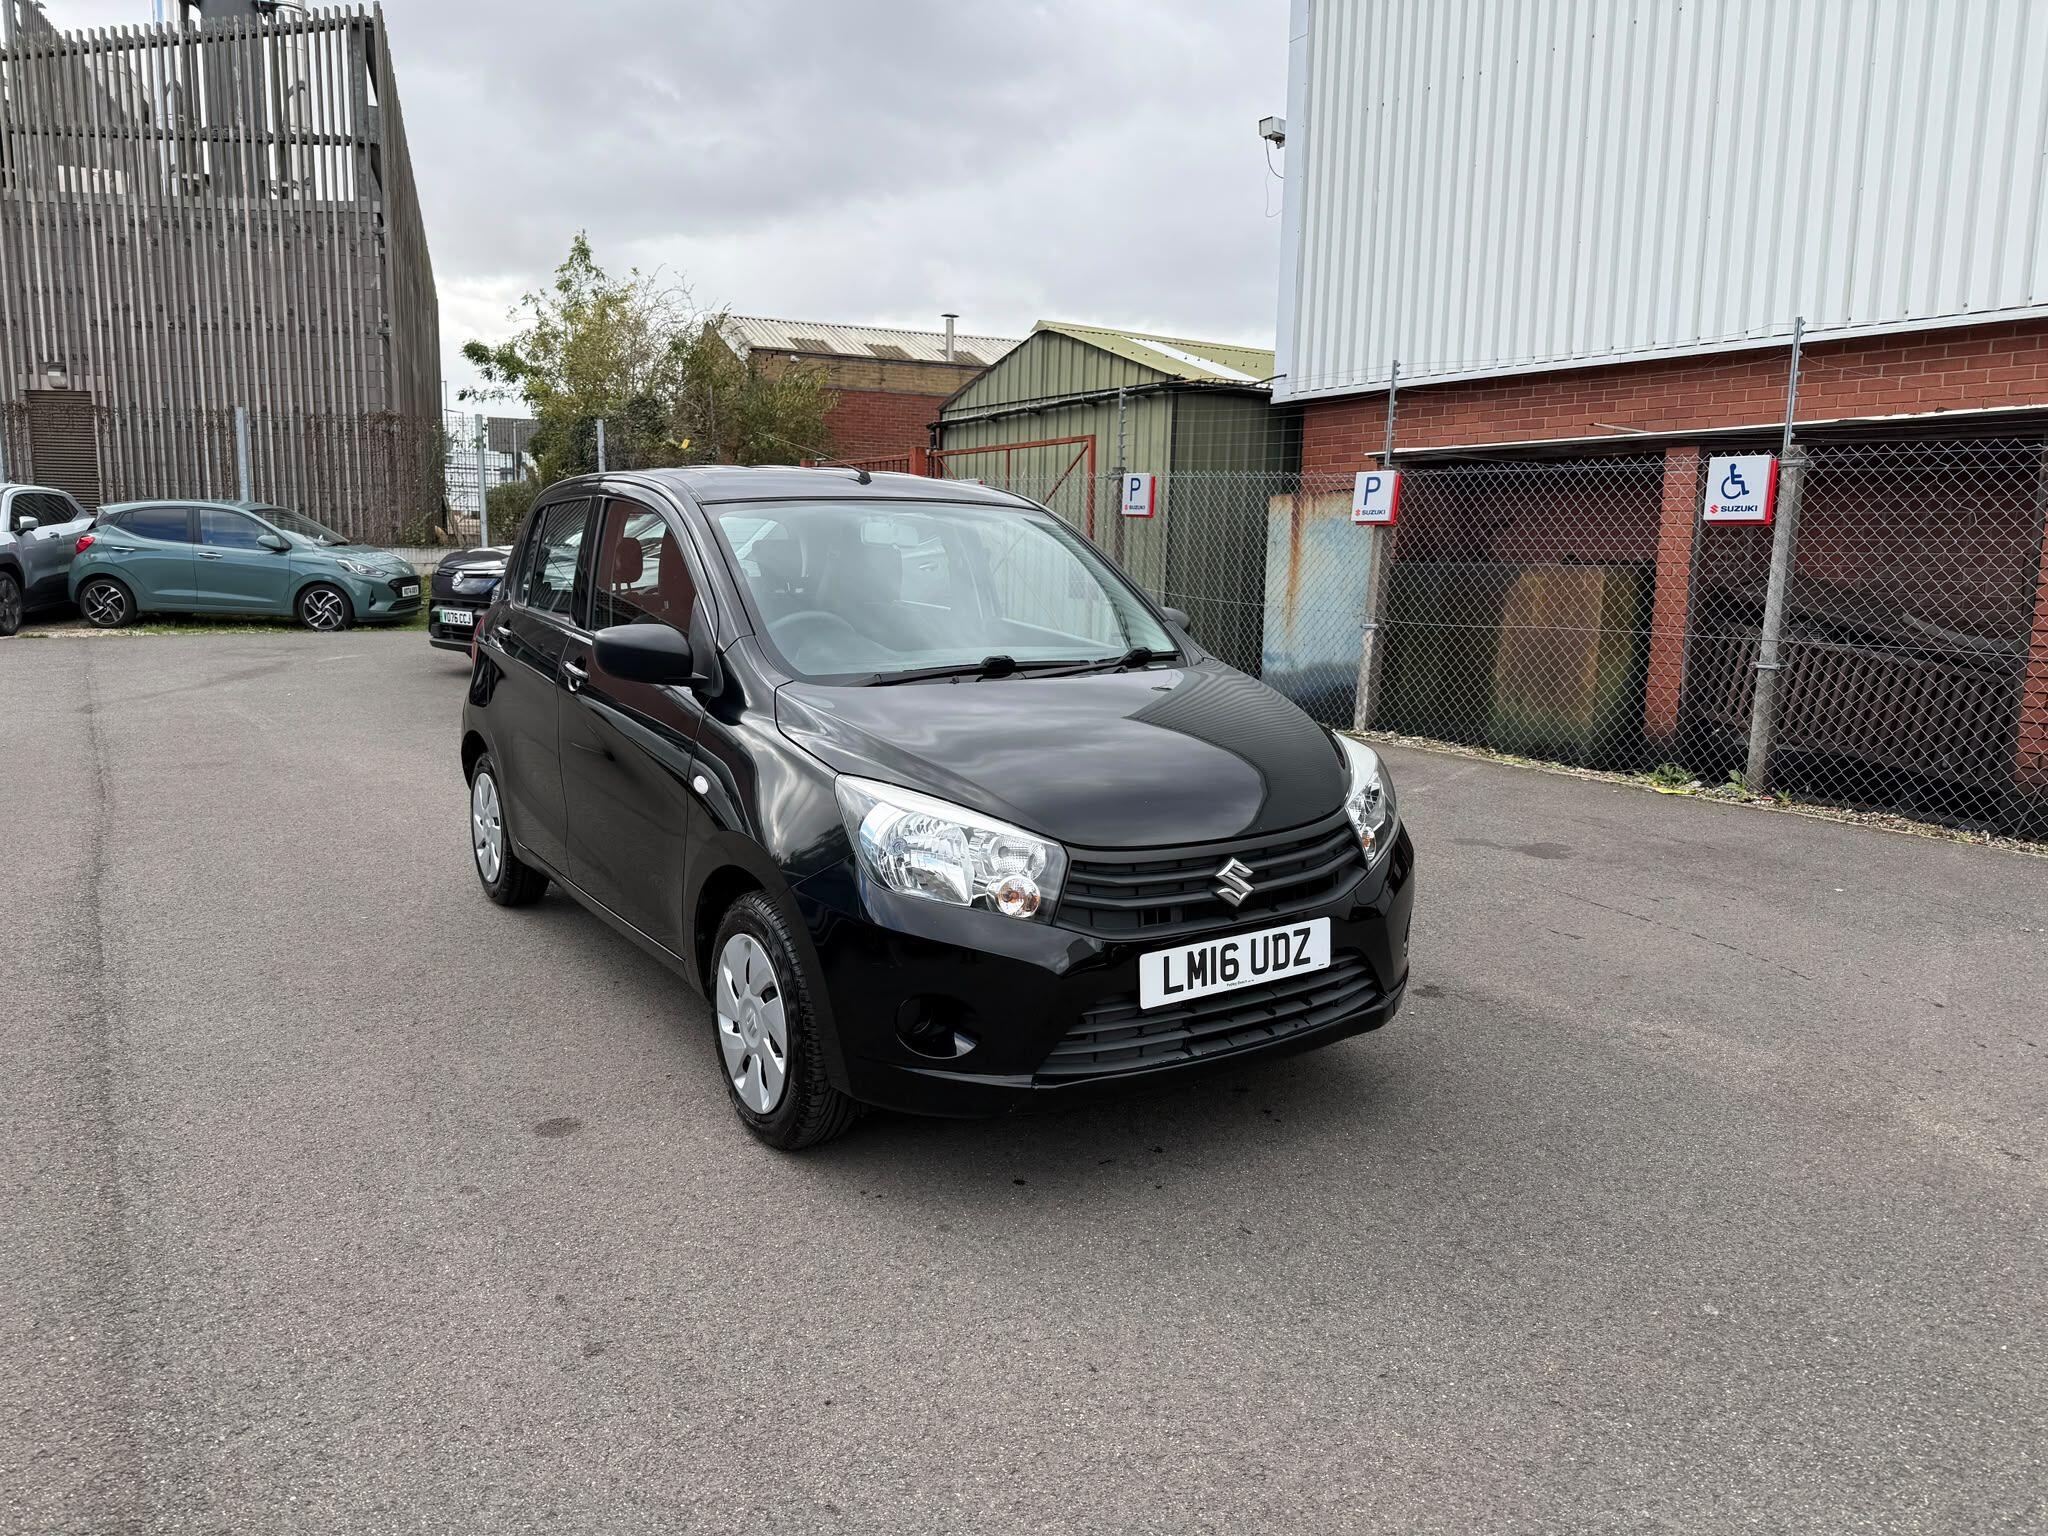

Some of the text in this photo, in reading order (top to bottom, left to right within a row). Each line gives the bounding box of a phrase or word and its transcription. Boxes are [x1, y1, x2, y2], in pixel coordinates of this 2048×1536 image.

[1130, 477, 1141, 501] P
[1363, 477, 1381, 506] P
[1721, 504, 1758, 512] SUZUKI
[1163, 927, 1311, 995] LM16 UDZ
